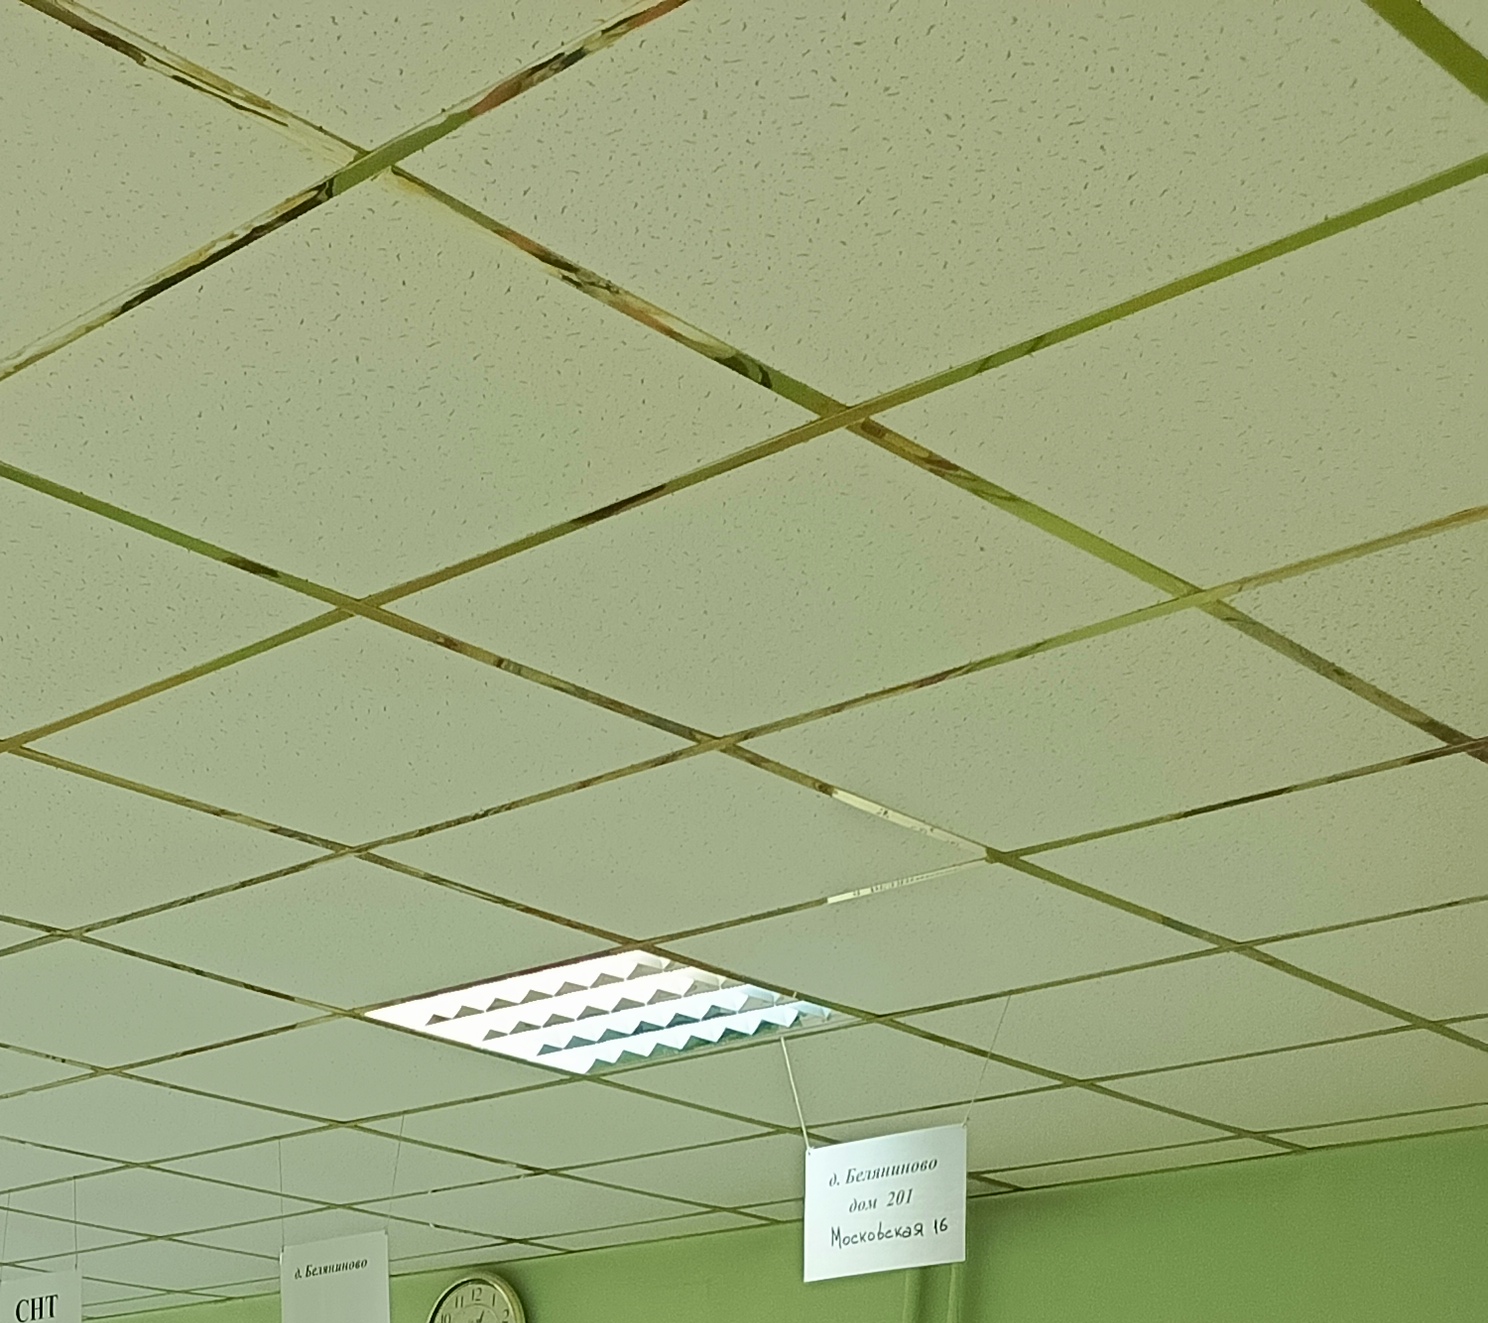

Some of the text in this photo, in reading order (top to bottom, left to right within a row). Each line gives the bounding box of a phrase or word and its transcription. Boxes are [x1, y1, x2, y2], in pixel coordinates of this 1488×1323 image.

[828, 1158, 939, 1187] д. Беляниново
[849, 1188, 914, 1213] дом 201
[830, 1217, 949, 1249] Московская 16
[305, 1258, 368, 1278] Беляниново
[455, 1295, 465, 1308] 11
[471, 1287, 483, 1301] 12
[15, 1294, 59, 1323] СНТ
[501, 1308, 510, 1323] 2
